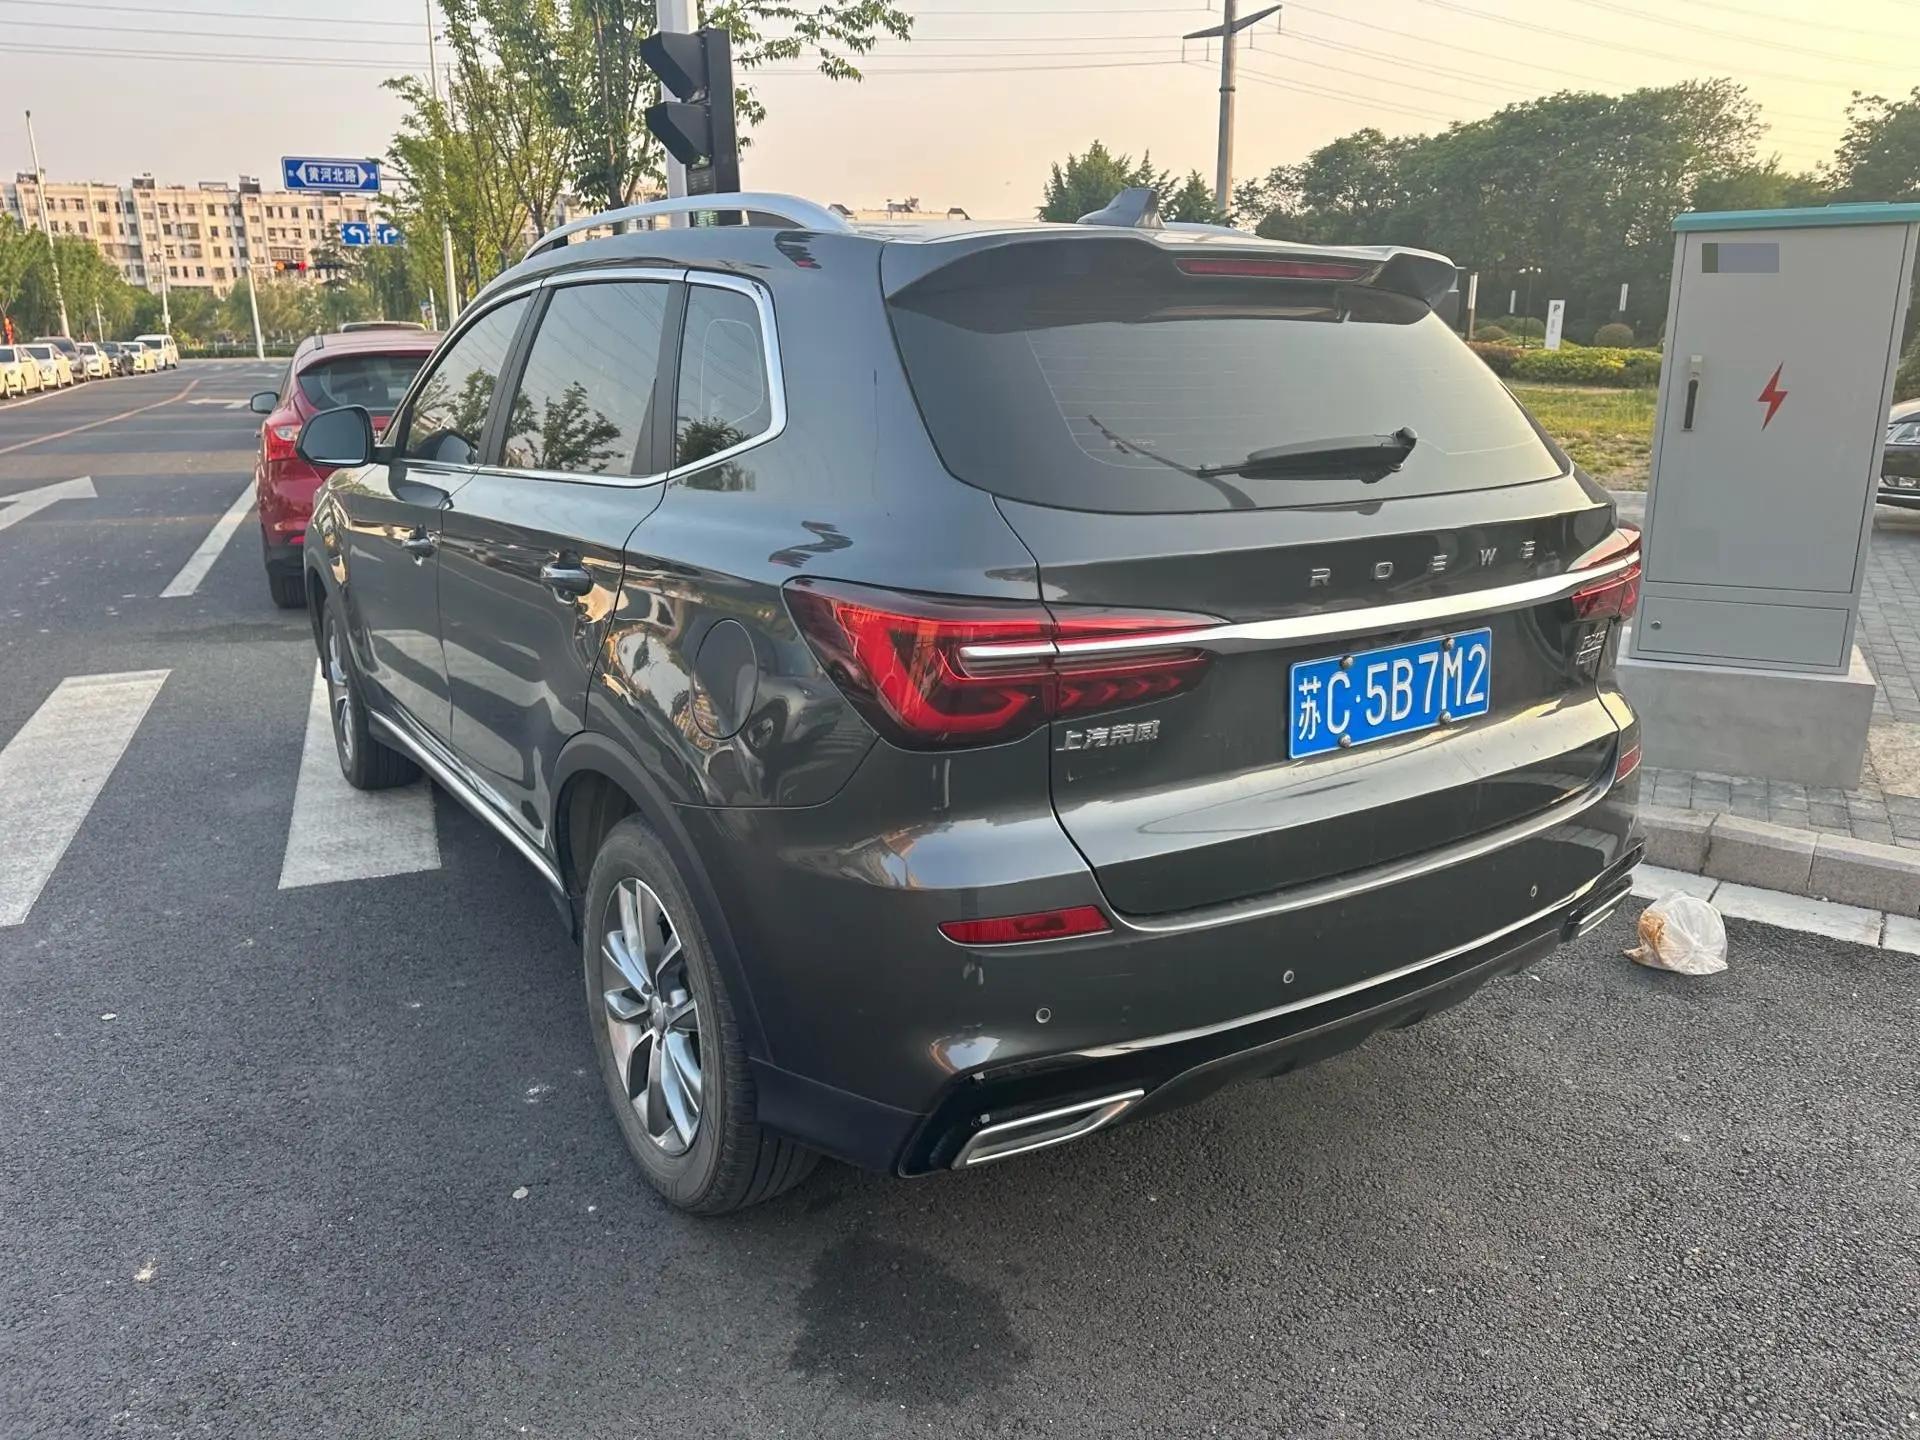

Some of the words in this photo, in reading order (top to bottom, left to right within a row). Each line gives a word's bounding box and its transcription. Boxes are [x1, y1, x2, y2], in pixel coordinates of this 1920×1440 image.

[308, 166, 357, 183] 黄河北路
[1309, 540, 1536, 587] ROEWE
[1055, 719, 1161, 751] 上汽荣威
